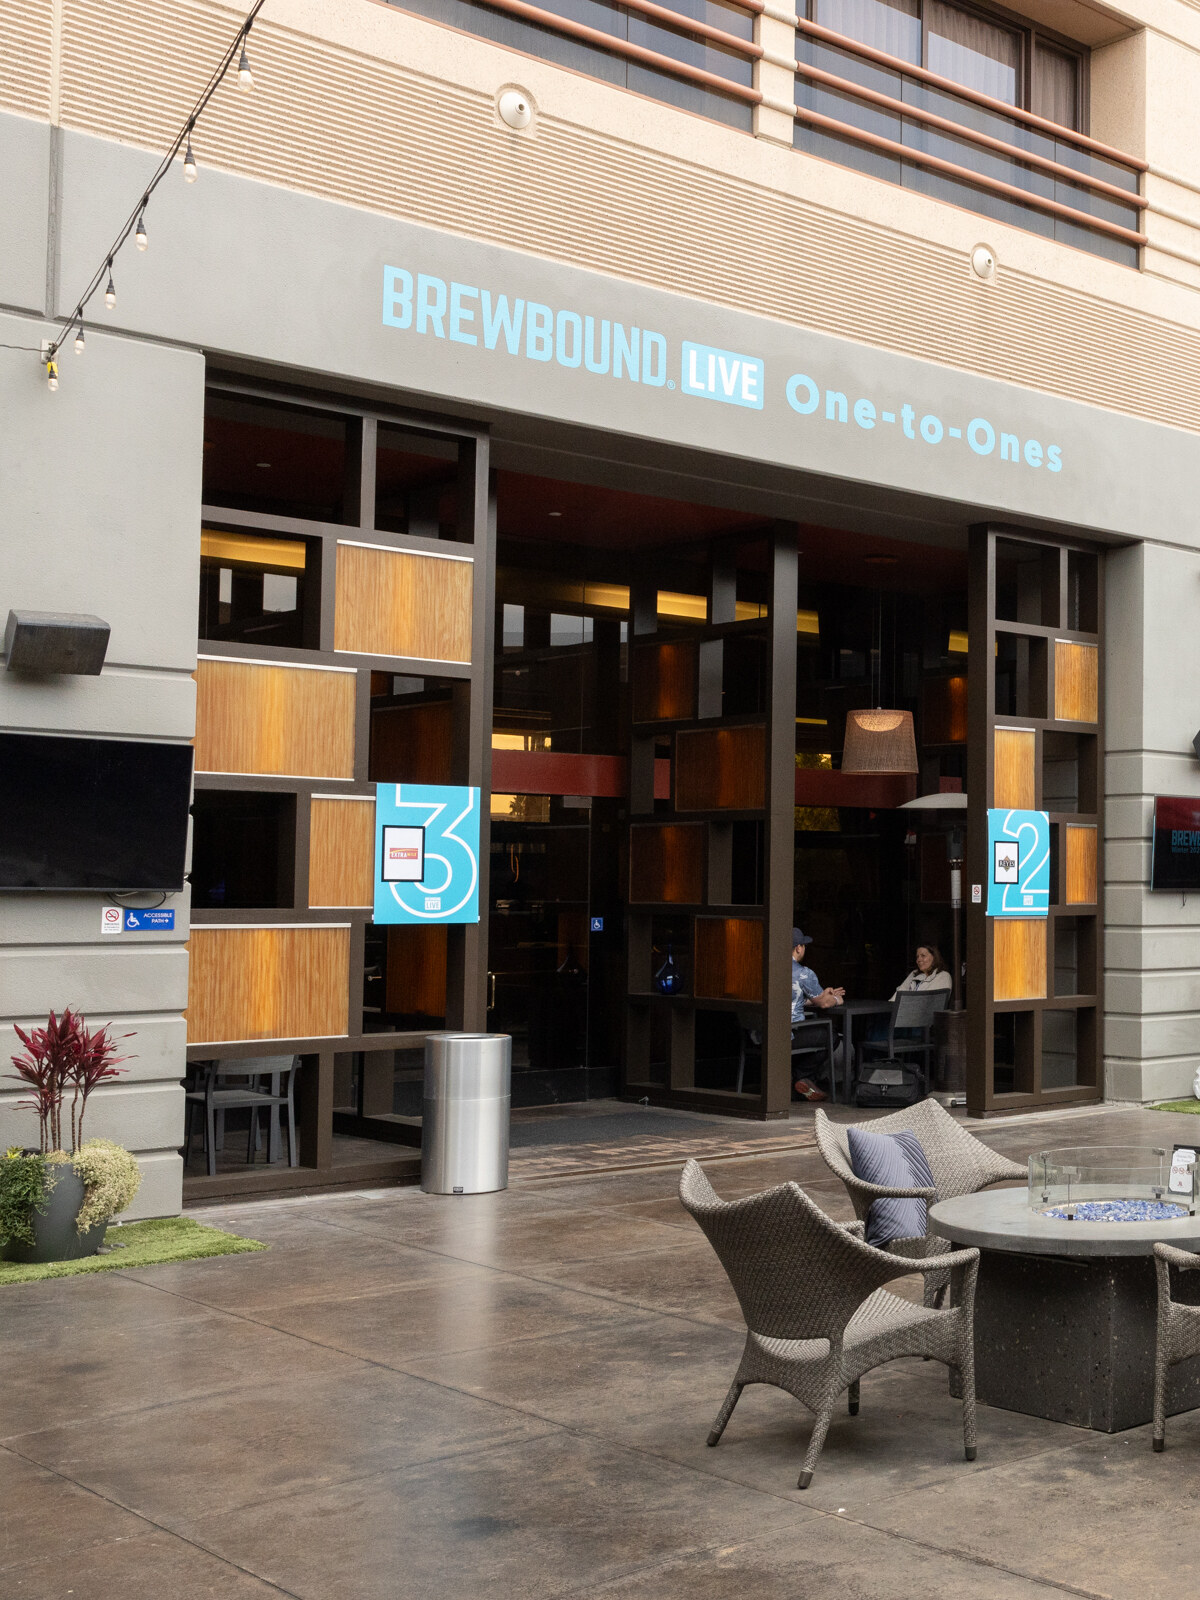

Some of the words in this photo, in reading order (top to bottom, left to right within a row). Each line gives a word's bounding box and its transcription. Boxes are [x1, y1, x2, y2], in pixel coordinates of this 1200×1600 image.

[688, 348, 758, 402] LIVE
[785, 373, 1063, 473] One-to-Ones
[389, 783, 477, 919] 3
[1002, 809, 1049, 912] 2
